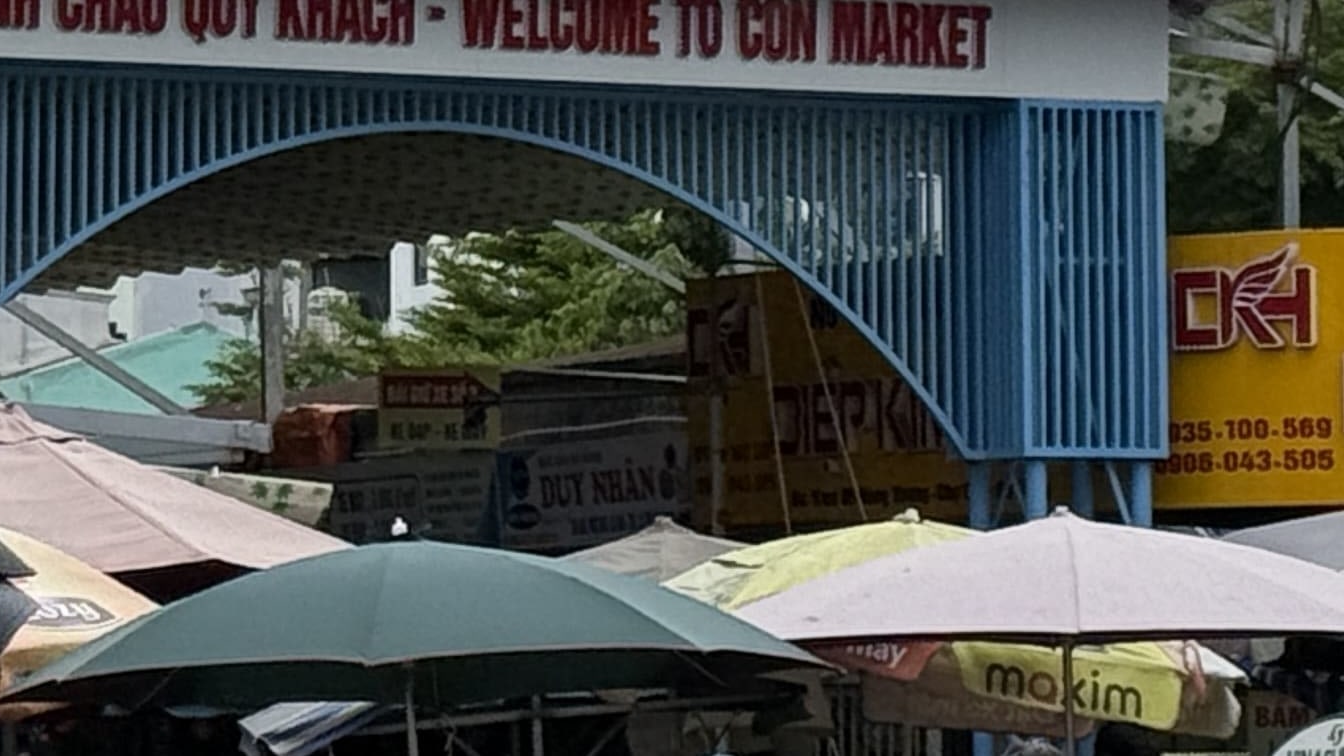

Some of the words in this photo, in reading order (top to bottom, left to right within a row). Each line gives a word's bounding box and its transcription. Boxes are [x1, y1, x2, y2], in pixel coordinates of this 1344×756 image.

[461, 0, 660, 55] WELCOME
[674, 0, 723, 57] TO
[736, 0, 817, 62] CON
[827, 0, 992, 69] MARKET
[29, 602, 101, 621] ozy
